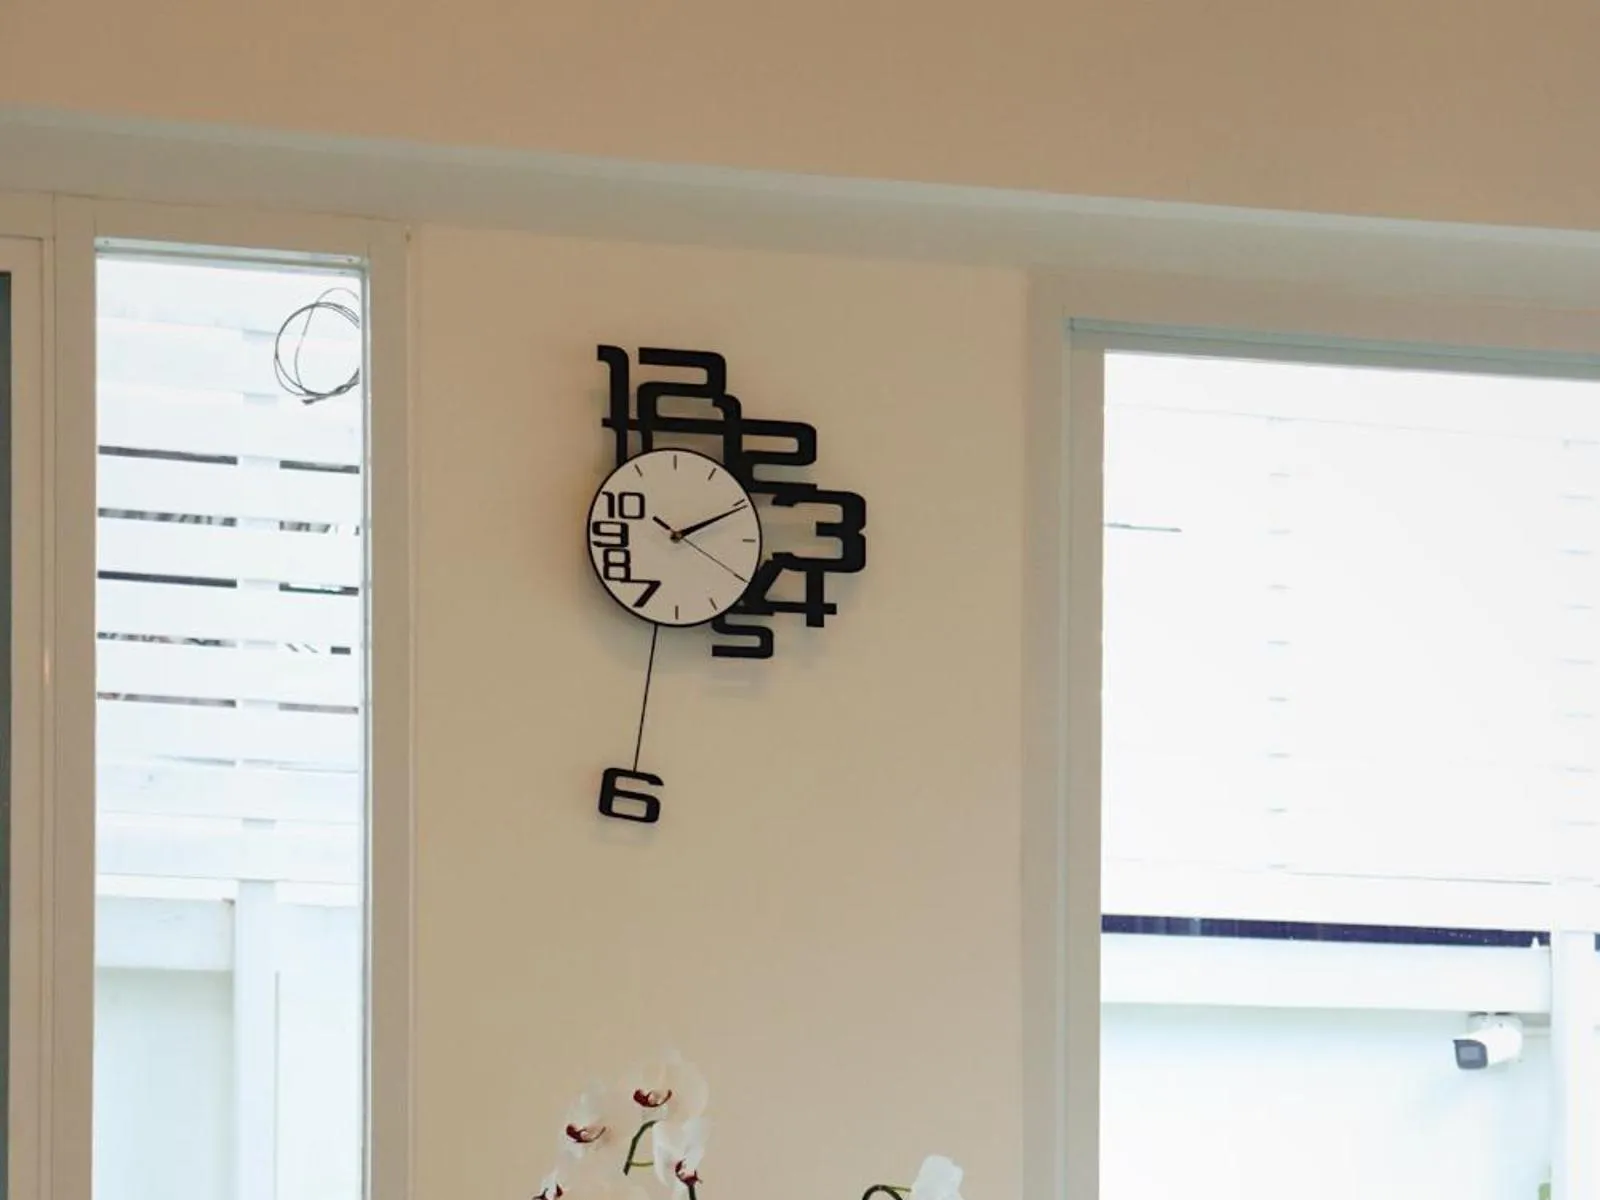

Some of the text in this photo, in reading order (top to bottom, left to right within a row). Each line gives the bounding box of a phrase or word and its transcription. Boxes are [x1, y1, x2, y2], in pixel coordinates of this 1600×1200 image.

[597, 344, 727, 433] 12
[601, 491, 646, 520] 10
[591, 521, 629, 548] 9
[771, 489, 867, 573] 3
[602, 548, 632, 581] 8
[620, 579, 662, 608] 7
[738, 556, 838, 628] 4
[598, 767, 664, 823] 6
